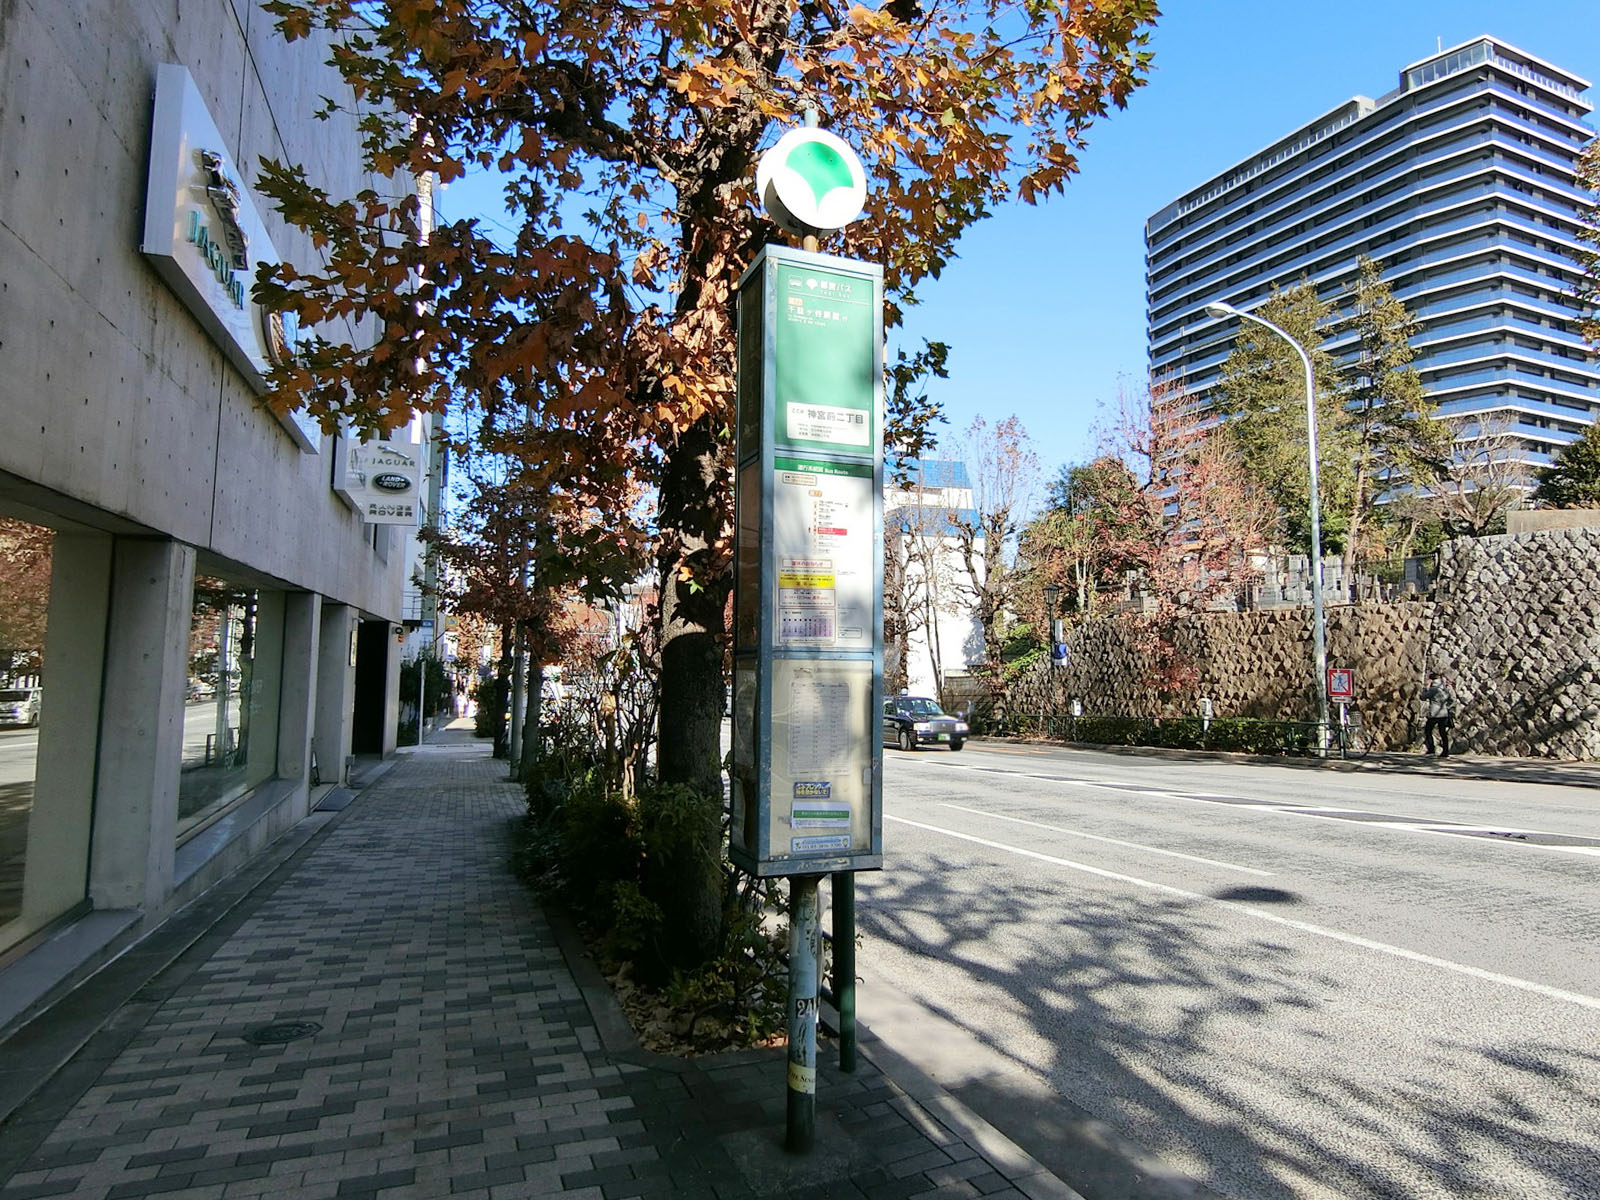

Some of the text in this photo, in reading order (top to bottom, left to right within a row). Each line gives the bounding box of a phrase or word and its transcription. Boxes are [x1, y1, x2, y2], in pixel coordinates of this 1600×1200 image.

[187, 210, 244, 310] JAGUAR
[808, 409, 864, 424] 神宮前二丁目
[372, 458, 415, 467] JAGUAR
[369, 503, 412, 511] RANGE
